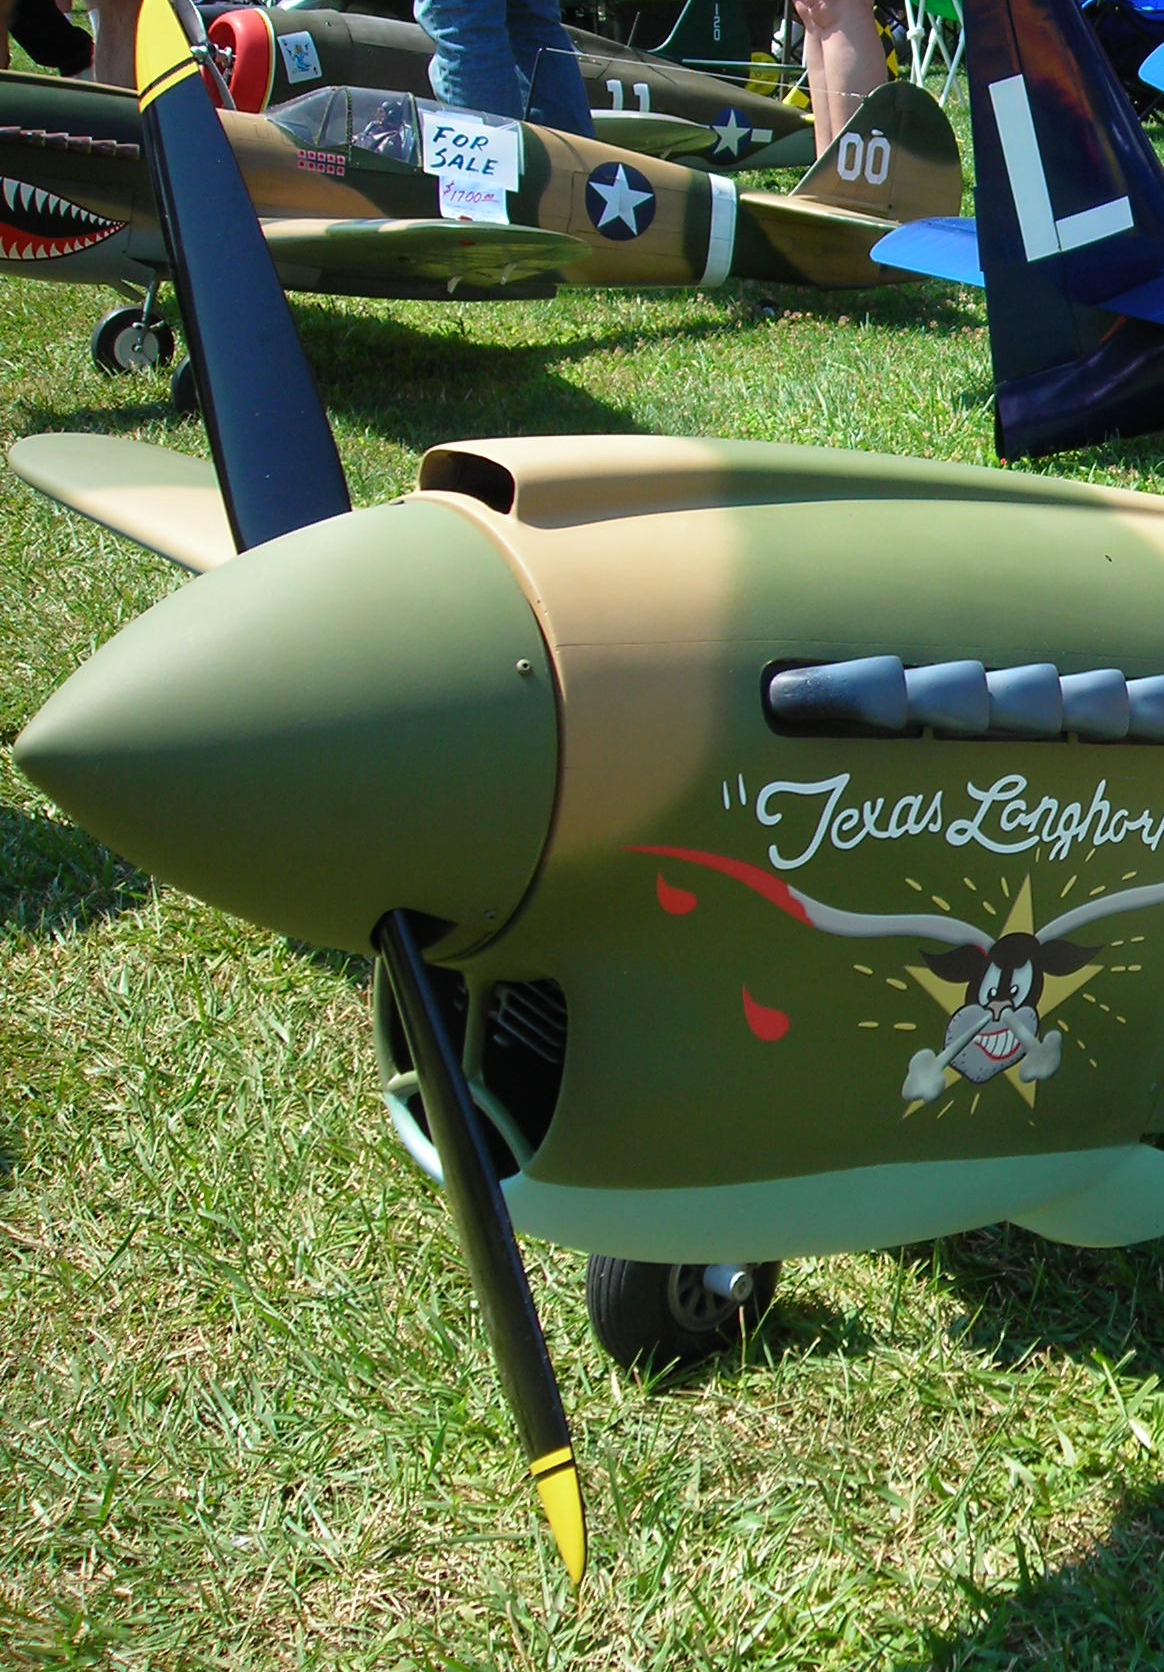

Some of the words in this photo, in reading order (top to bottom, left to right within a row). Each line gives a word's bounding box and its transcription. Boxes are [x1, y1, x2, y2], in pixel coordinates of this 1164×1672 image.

[432, 126, 489, 151] FOR
[837, 131, 891, 185] 00
[430, 148, 499, 176] SALE
[988, 73, 1134, 262] L
